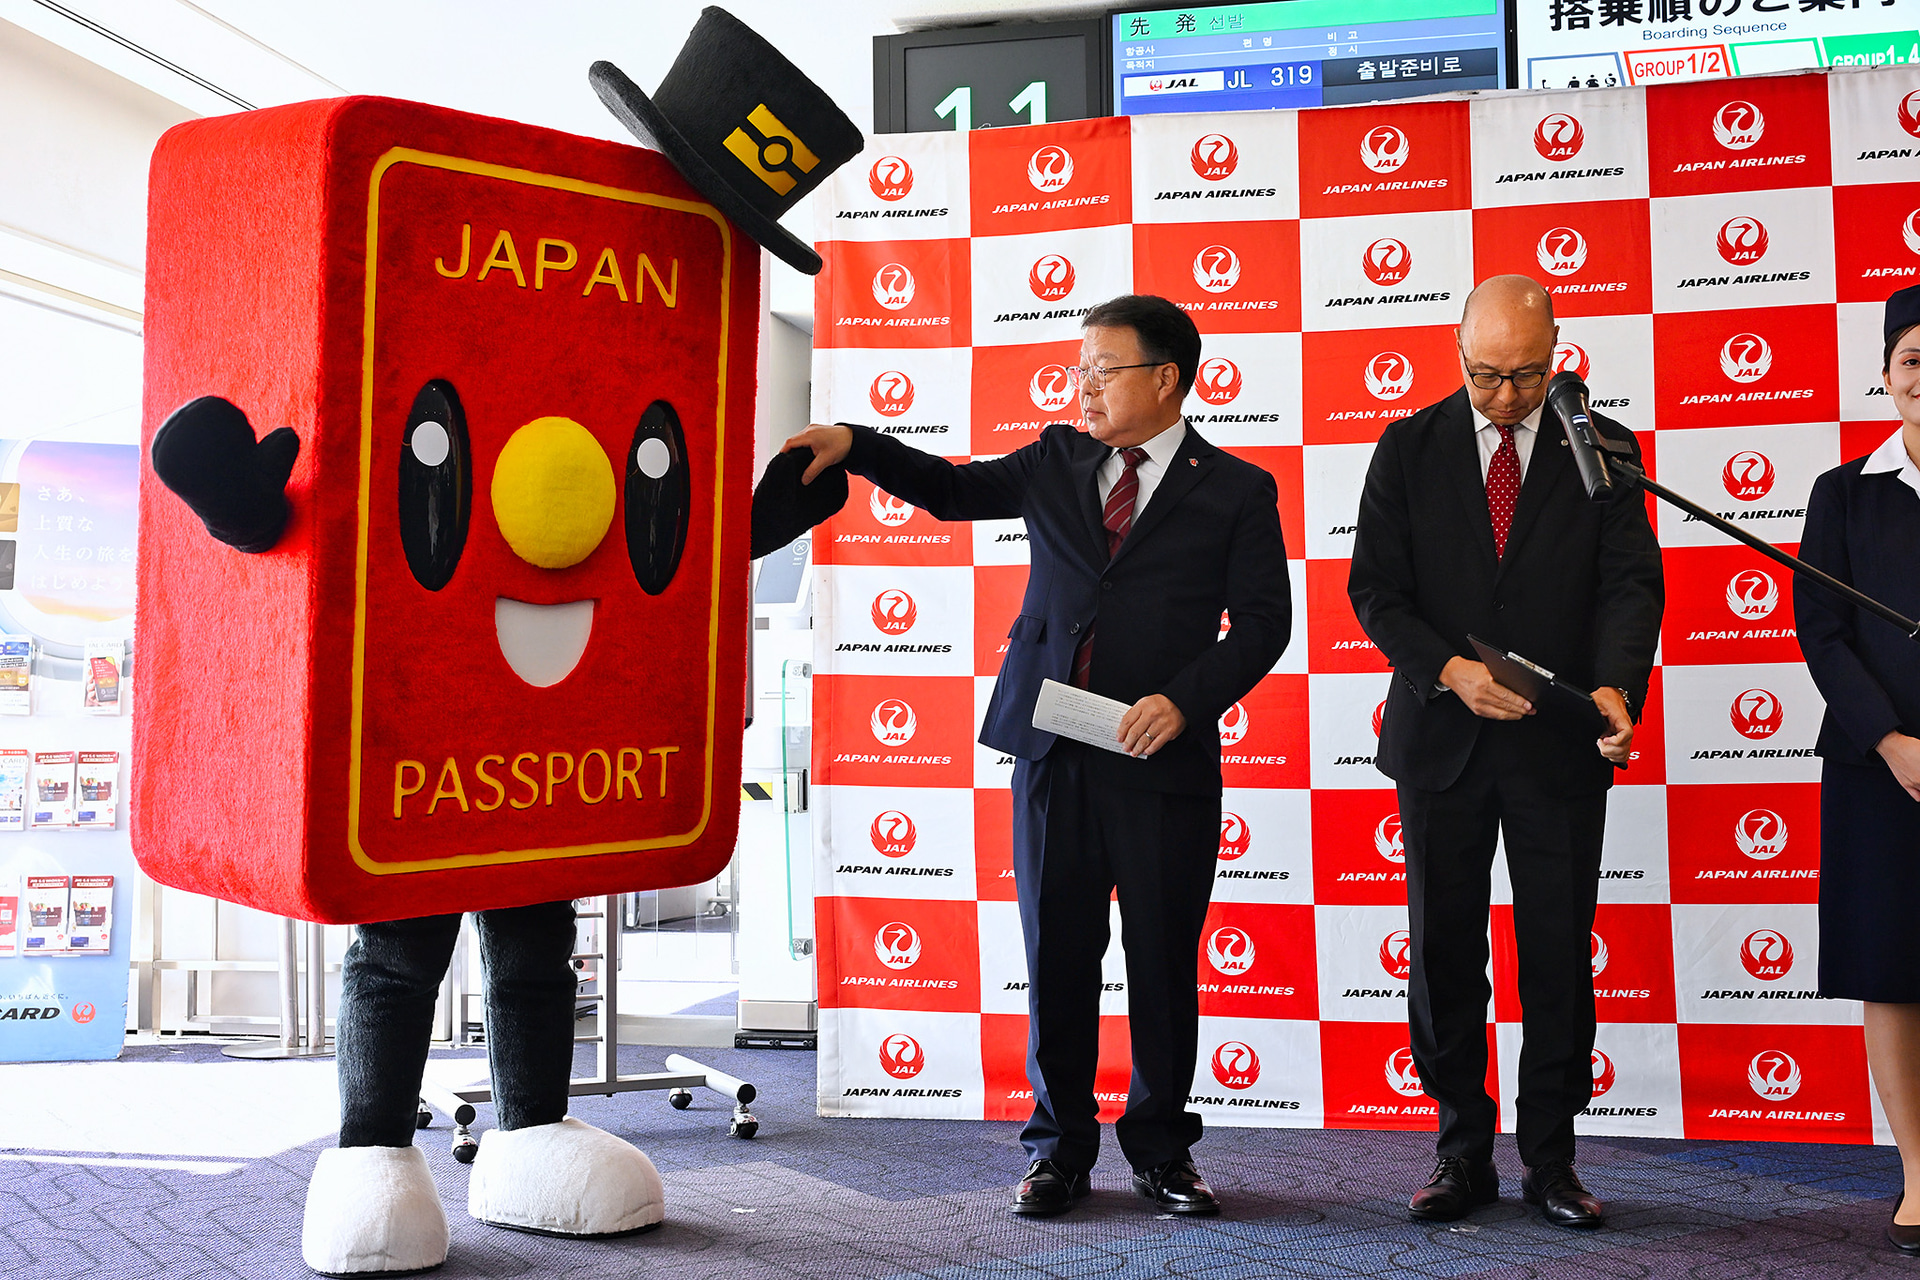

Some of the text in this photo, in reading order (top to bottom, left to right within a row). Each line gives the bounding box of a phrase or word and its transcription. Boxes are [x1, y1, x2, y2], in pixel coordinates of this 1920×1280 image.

[1210, 14, 1245, 31] 선발
[1643, 21, 1787, 41] Boarding Sequence
[1126, 46, 1155, 57] 항공사
[1126, 60, 1155, 70] 목적지
[1165, 56, 1462, 89] JAL JL 319 출발준비로
[1727, 135, 1755, 144] JAL
[1548, 147, 1575, 156] JAL
[1857, 149, 1912, 160] JAPAN
[1374, 159, 1400, 168] JAL
[1674, 155, 1806, 172] JAPAN AIRLINES
[1203, 167, 1229, 176] JAL
[1495, 167, 1624, 183] JAPAN AIRLINES
[1040, 179, 1065, 187] JAL
[1323, 179, 1448, 195] JAPAN AIRLINES
[881, 188, 905, 196] JAL
[1154, 188, 1276, 200] JAPAN AIRLINES
[992, 195, 1110, 214] JAPAN AIRLINES
[836, 208, 949, 219] JAPAN AIRLINES
[1731, 251, 1759, 260] JAL
[435, 223, 679, 308] JAPAN
[1551, 261, 1577, 270] JAL
[1376, 272, 1402, 281] JAL
[1862, 267, 1916, 277] JAPAN
[1206, 279, 1231, 287] JAL
[1677, 271, 1810, 288] JAPAN AIRLINES
[1041, 287, 1067, 296] JAL
[1552, 282, 1628, 294] AIRLINES
[884, 296, 907, 304] JAL
[1325, 292, 1450, 307] JAPAN AIRLINES
[1175, 301, 1278, 311] PAN AIRLINES
[994, 308, 1090, 322] JAPAN AIRLIN
[836, 316, 950, 326] JAPAN AIRLINES
[1734, 367, 1762, 377] JAL
[1378, 386, 1404, 394] JAL
[1207, 391, 1232, 399] JAL
[1680, 389, 1814, 405] JAPAN AIRLINES
[1042, 398, 1067, 406] JAL
[1588, 398, 1630, 409] INES
[881, 403, 906, 411] JAL
[1209, 413, 1279, 423] AIRLINES
[1326, 408, 1420, 421] JAPAN AIRL
[882, 425, 949, 434] AIRLINES
[993, 421, 1040, 432] JAPAN
[1737, 486, 1765, 495] JAL
[883, 513, 907, 521] JAL
[1682, 511, 1735, 522] JAAN
[33, 514, 94, 532] 上質な
[1328, 526, 1357, 535] JAP
[835, 535, 951, 543] JAPAN AIRLINES
[995, 533, 1029, 542] JAPA
[33, 544, 133, 562] 人生の旅を
[1741, 605, 1769, 614] JAL
[884, 621, 908, 630] JAL
[1686, 629, 1797, 640] JAPAN AIRLIN
[835, 644, 952, 653] JAPAN AIRLINES
[1745, 725, 1773, 733] JAL
[883, 732, 907, 741] JAL
[1220, 732, 1239, 740] AL
[1690, 748, 1814, 759] JAPAN AIRLINE
[834, 754, 952, 765] JAPAN AIRLINES
[394, 746, 680, 819] PASSPORT
[883, 844, 908, 853] JAL
[1389, 849, 1405, 857] JA
[1750, 845, 1778, 854] JAL
[836, 865, 953, 877] JAPAN AIRLINES
[1217, 870, 1290, 880] AIRLINES
[1598, 870, 1644, 879] LINES
[1695, 869, 1820, 879] JAPAN AIRLINE
[1337, 873, 1387, 882] JAPAN
[887, 955, 912, 964] JAL
[1220, 961, 1246, 970] JAL
[1394, 965, 1410, 974] JA
[1756, 966, 1784, 974] JAL
[841, 976, 958, 989] JAPAN AIRLINES
[1003, 982, 1030, 991] JAP
[1222, 985, 1295, 996] AIRLINES
[1342, 989, 1392, 998] JAPAN
[1593, 989, 1650, 998] RLINES
[1701, 990, 1822, 999] JAPAN AIRLIN
[0, 1008, 60, 1020] ARD
[892, 1065, 917, 1074] JAL
[1225, 1076, 1251, 1085] JAL
[843, 1088, 962, 1098] JAPAN AIRLINES
[1007, 1090, 1033, 1099] JAP
[1764, 1086, 1792, 1095] JAL
[1186, 1096, 1300, 1110] APAN AIRLINES
[1347, 1105, 1438, 1115] JAPAN AIRL
[1580, 1107, 1658, 1116] AIRLINES
[1709, 1109, 1845, 1121] JAPAN AIRLINES
